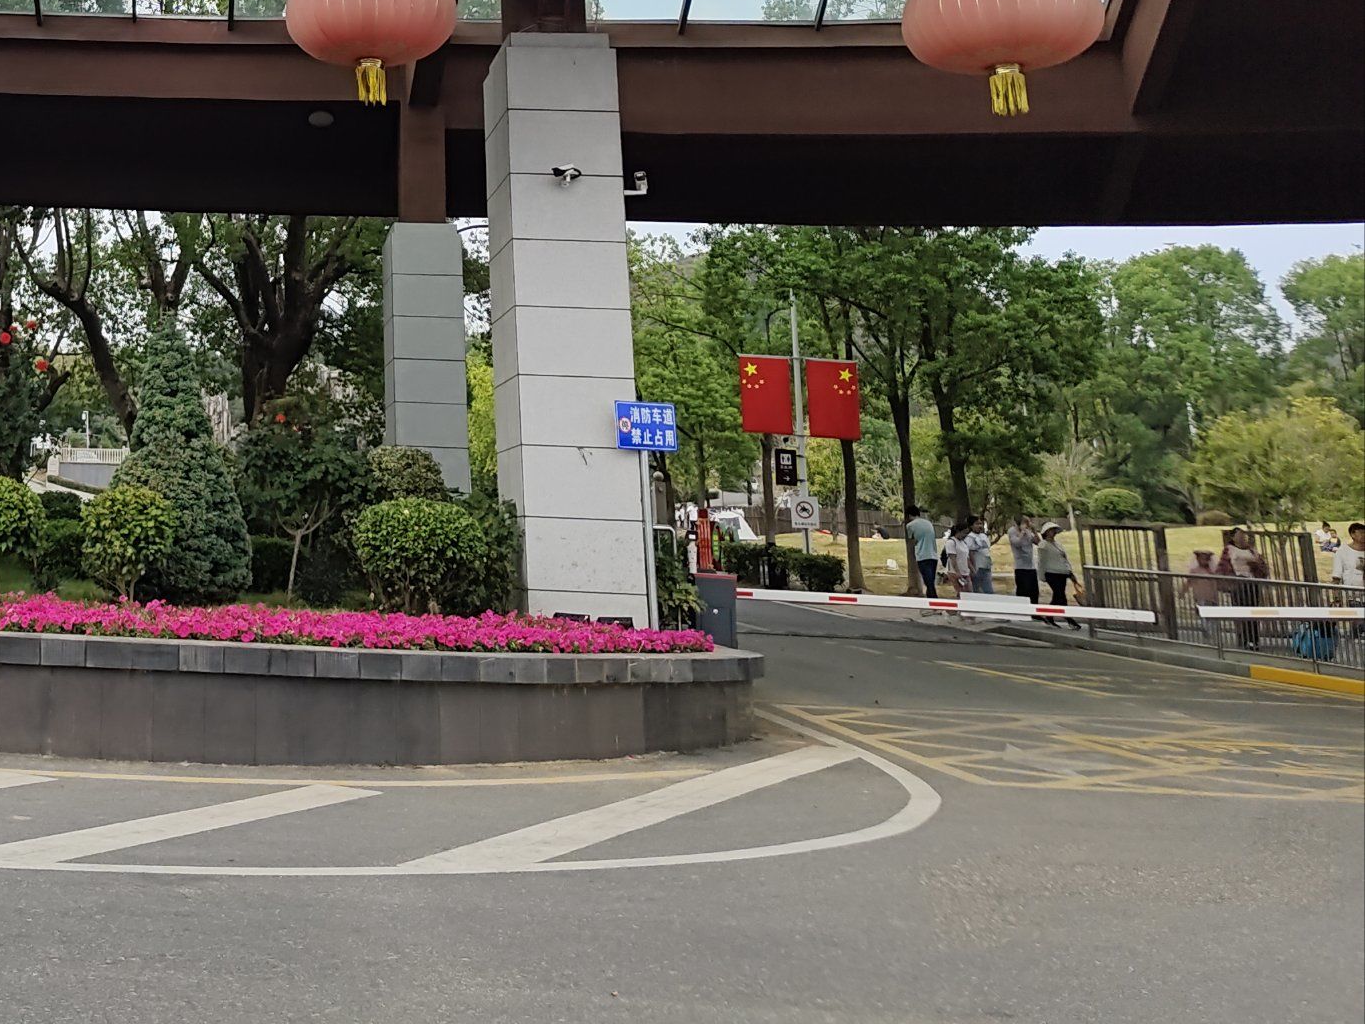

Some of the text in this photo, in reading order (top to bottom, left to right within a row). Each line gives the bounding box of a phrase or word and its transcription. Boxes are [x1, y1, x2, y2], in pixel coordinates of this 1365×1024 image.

[630, 406, 674, 425] 消防车道
[631, 427, 675, 447] 禁止占用
